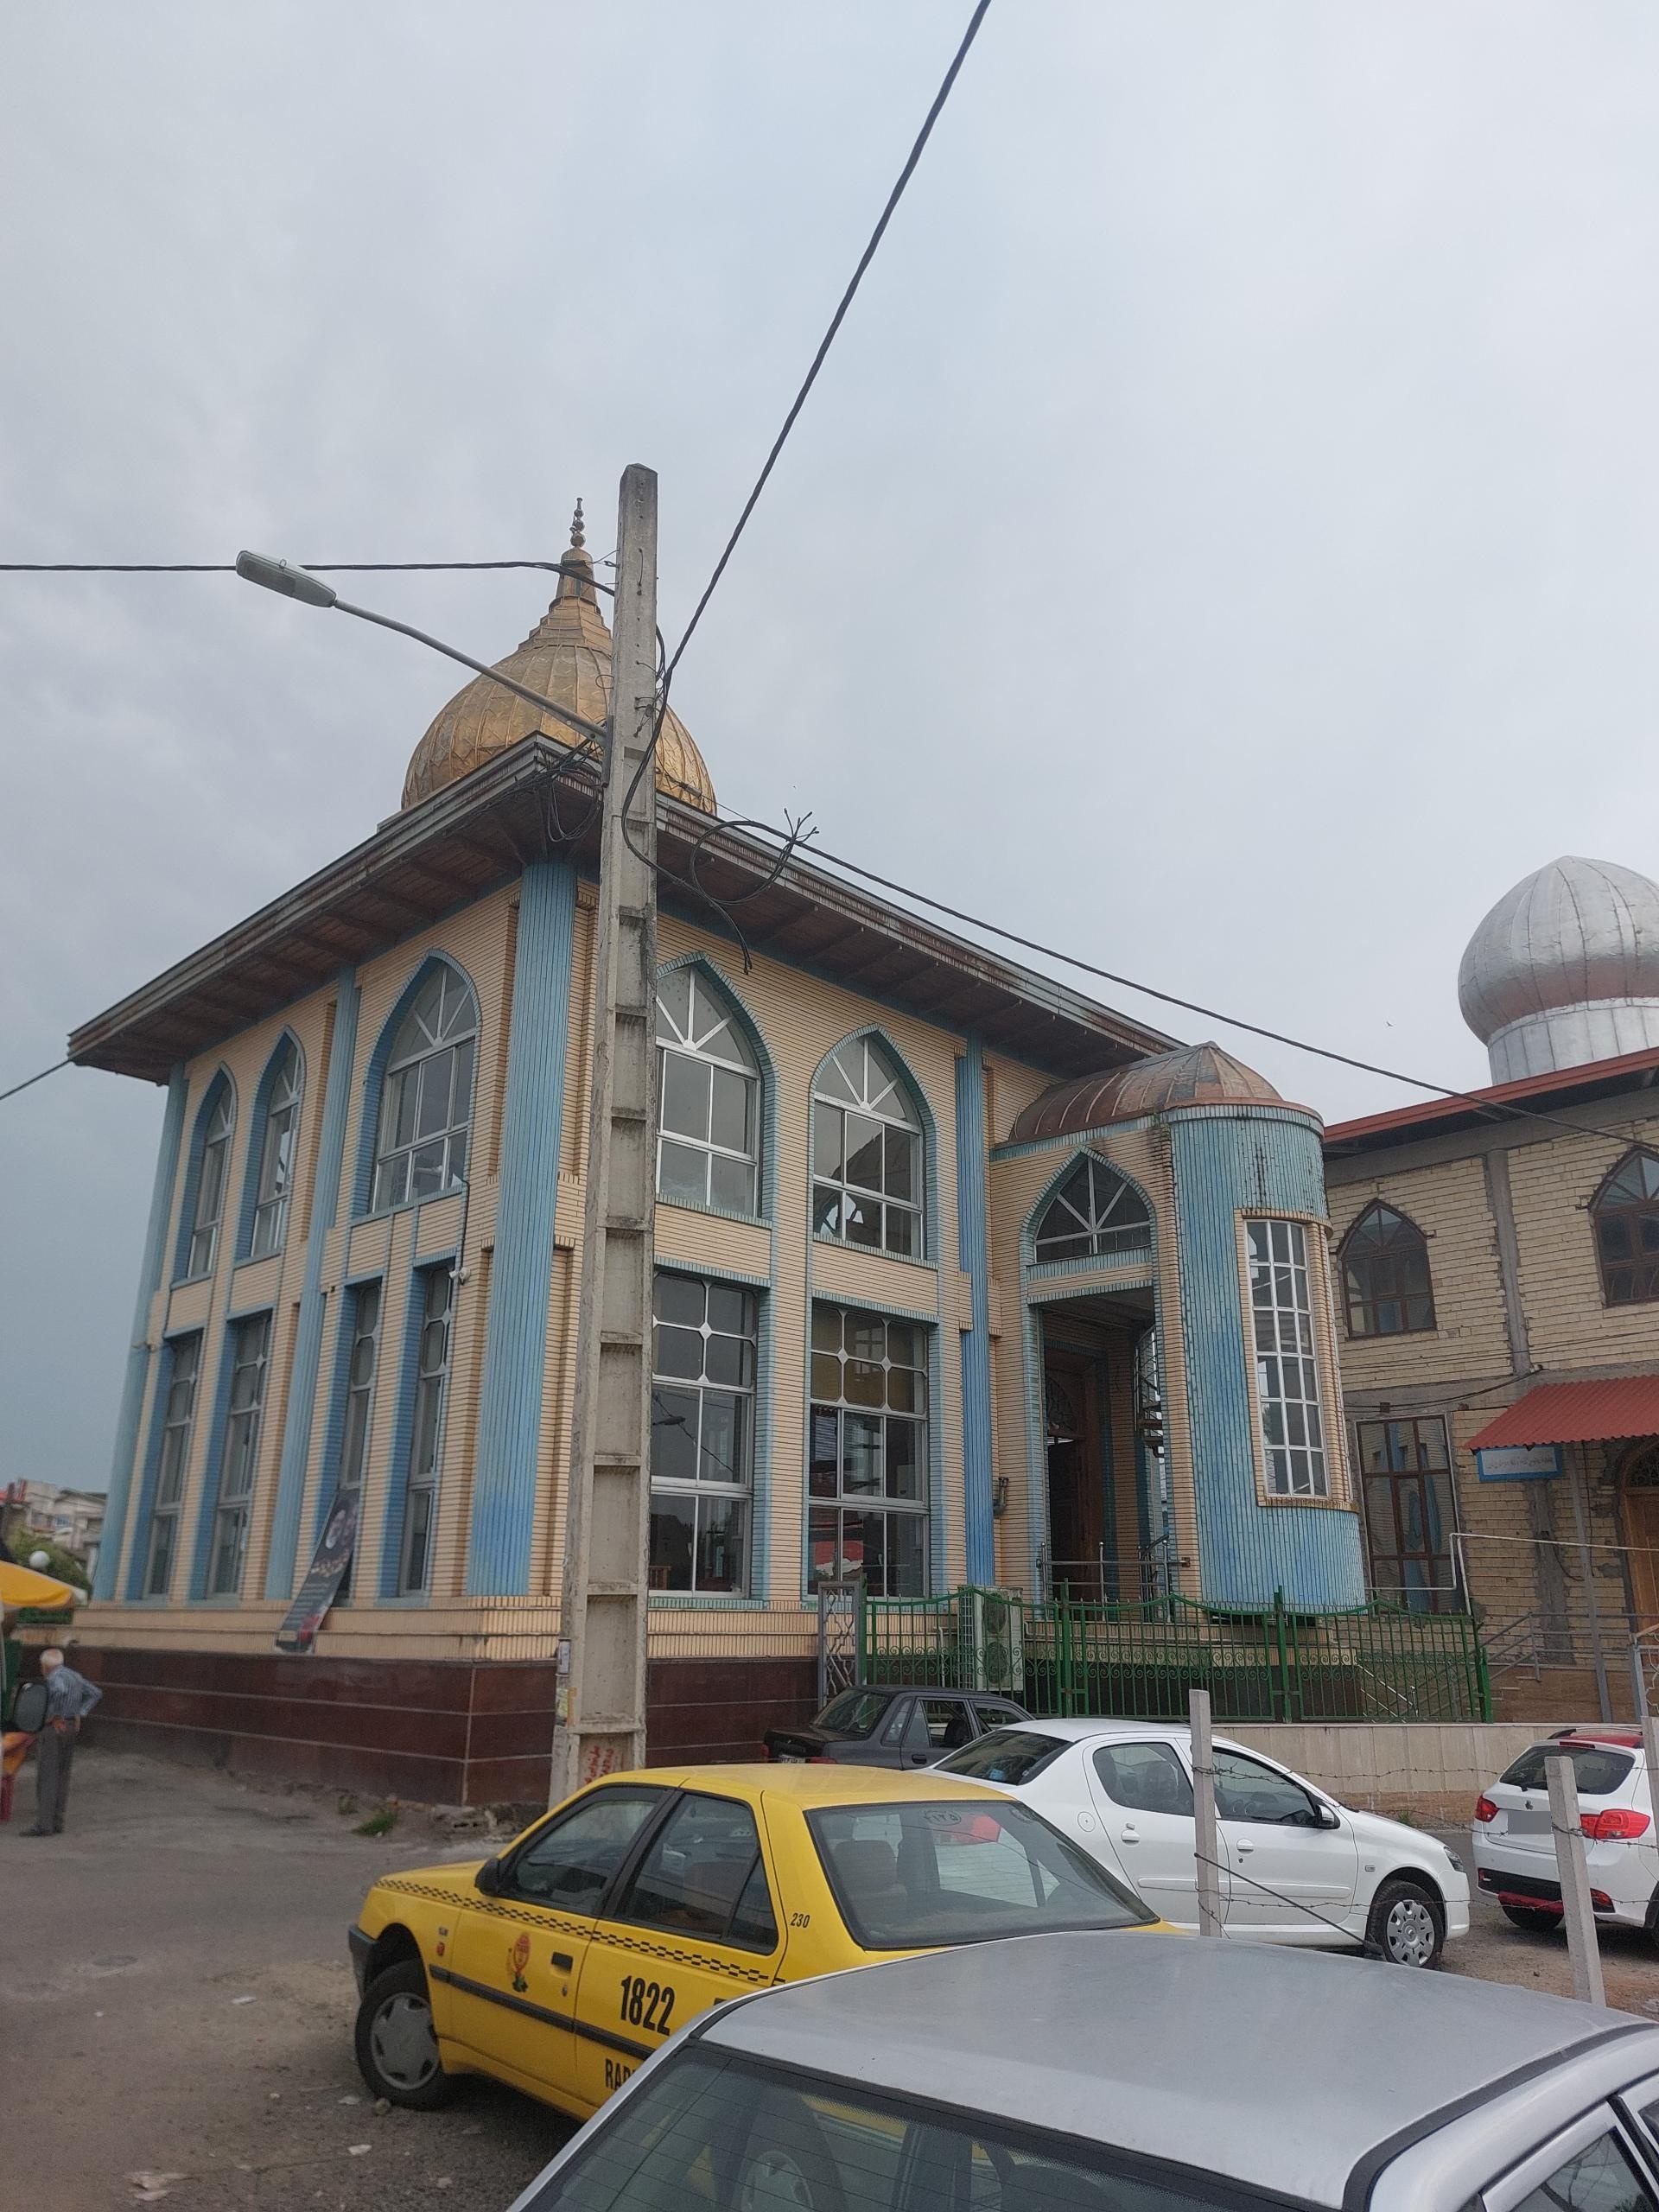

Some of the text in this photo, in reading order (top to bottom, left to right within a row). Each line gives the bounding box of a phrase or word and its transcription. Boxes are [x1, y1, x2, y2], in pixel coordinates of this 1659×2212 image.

[790, 1912, 810, 1928] 230
[620, 1975, 675, 2037] 1822
[605, 2058, 636, 2090] RAD
